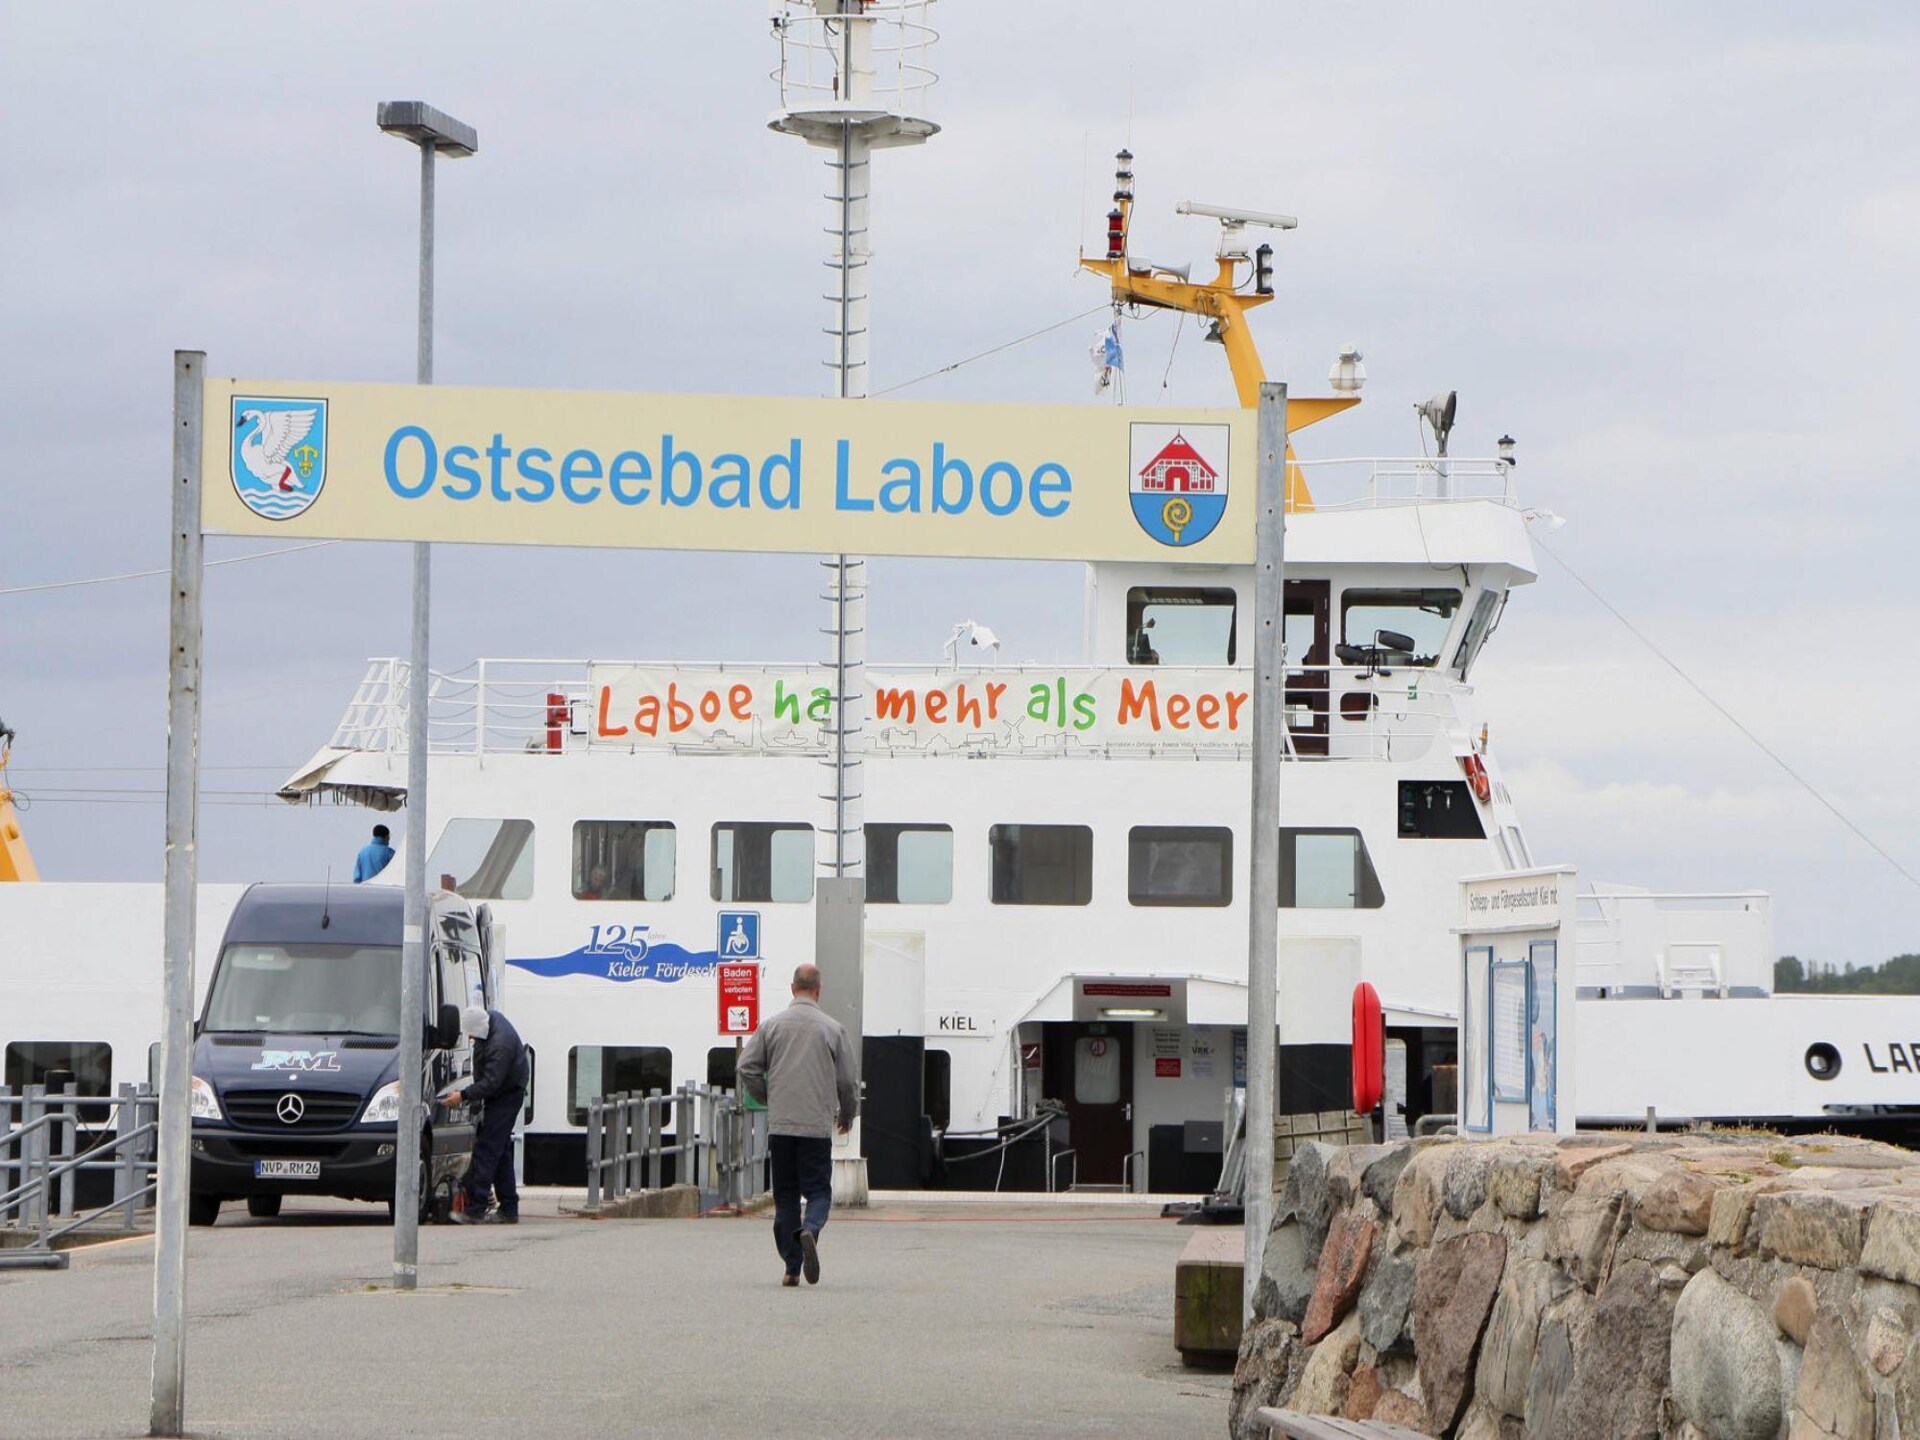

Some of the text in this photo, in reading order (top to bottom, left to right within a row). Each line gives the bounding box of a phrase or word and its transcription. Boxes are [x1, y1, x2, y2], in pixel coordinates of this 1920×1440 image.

[383, 425, 1072, 517] Ostseebad Laboe
[597, 676, 1248, 737] Laboe ha mehr als Meer
[584, 925, 650, 961] 125
[607, 962, 649, 977] Kieler
[723, 967, 752, 978] Baden
[724, 986, 753, 994] verboten
[940, 1016, 977, 1030] KIEL
[261, 1161, 283, 1173] NVP
